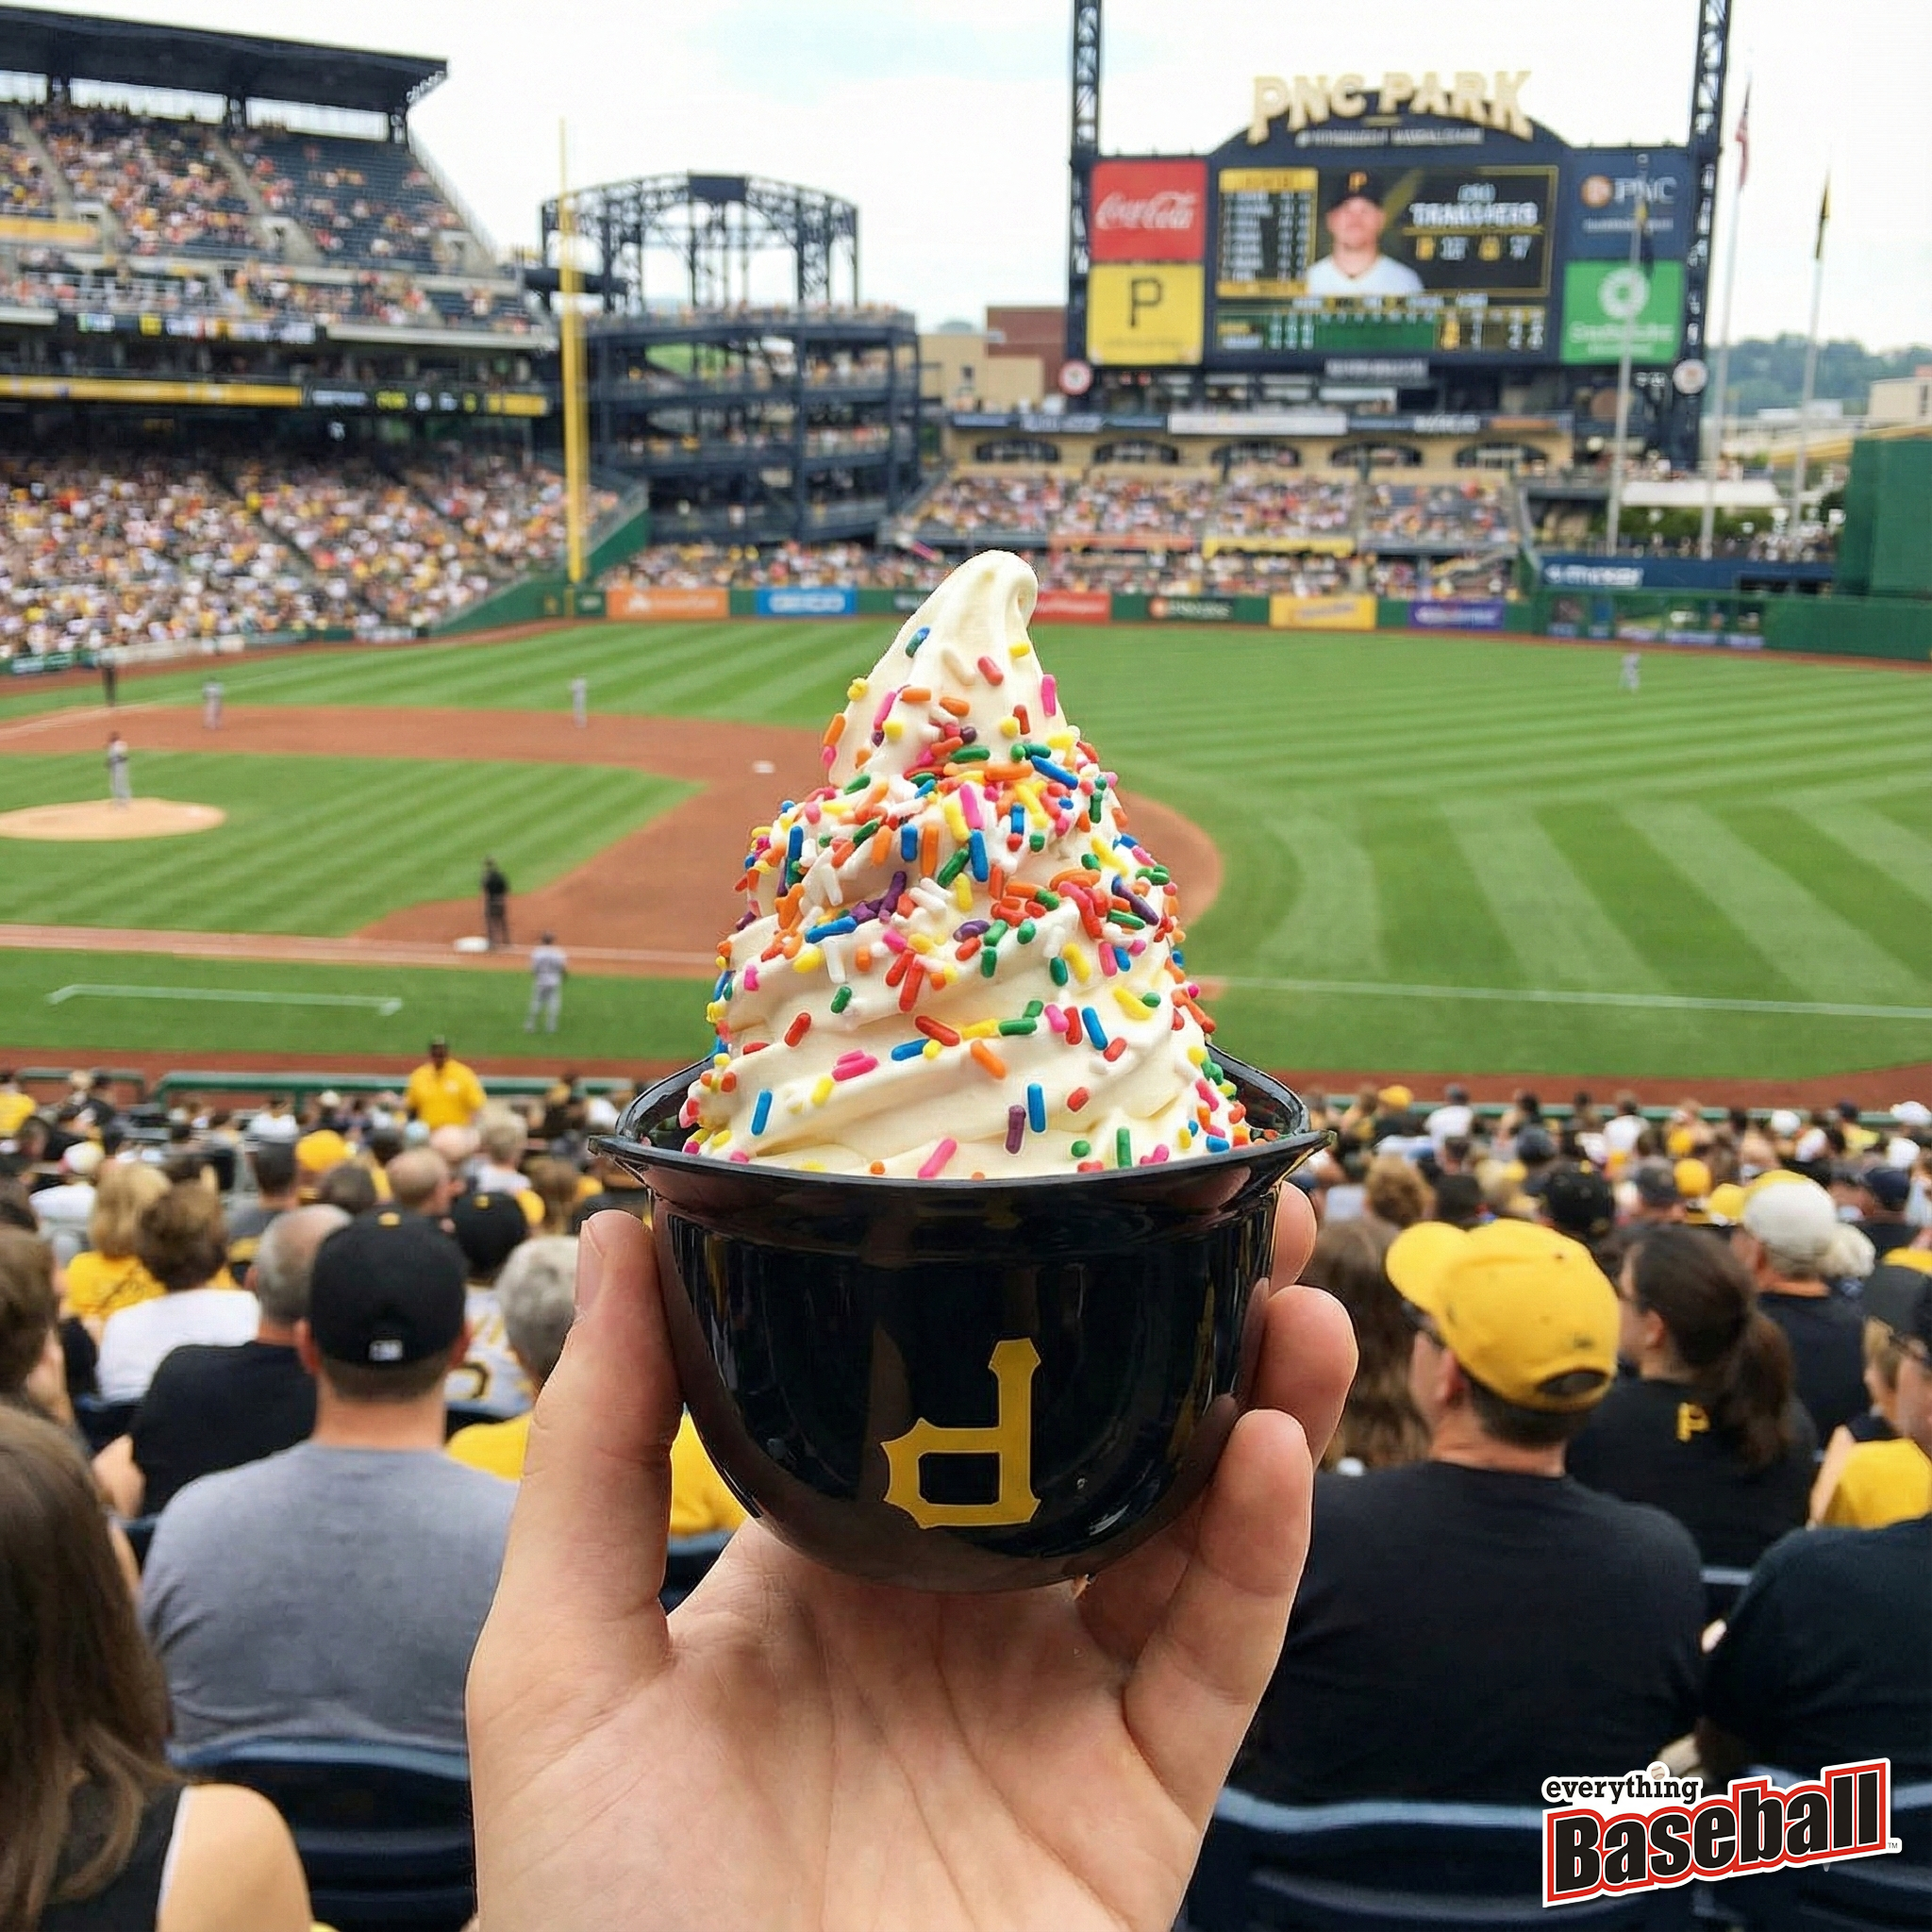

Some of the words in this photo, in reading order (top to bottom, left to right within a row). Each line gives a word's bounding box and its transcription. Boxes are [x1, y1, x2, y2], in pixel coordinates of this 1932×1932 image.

[1246, 73, 1367, 145] PNC
[1377, 71, 1534, 142] PARK
[1614, 176, 1678, 206] PNC
[1130, 277, 1164, 328] P
[880, 1337, 1041, 1530] P
[1677, 1402, 1710, 1443] P
